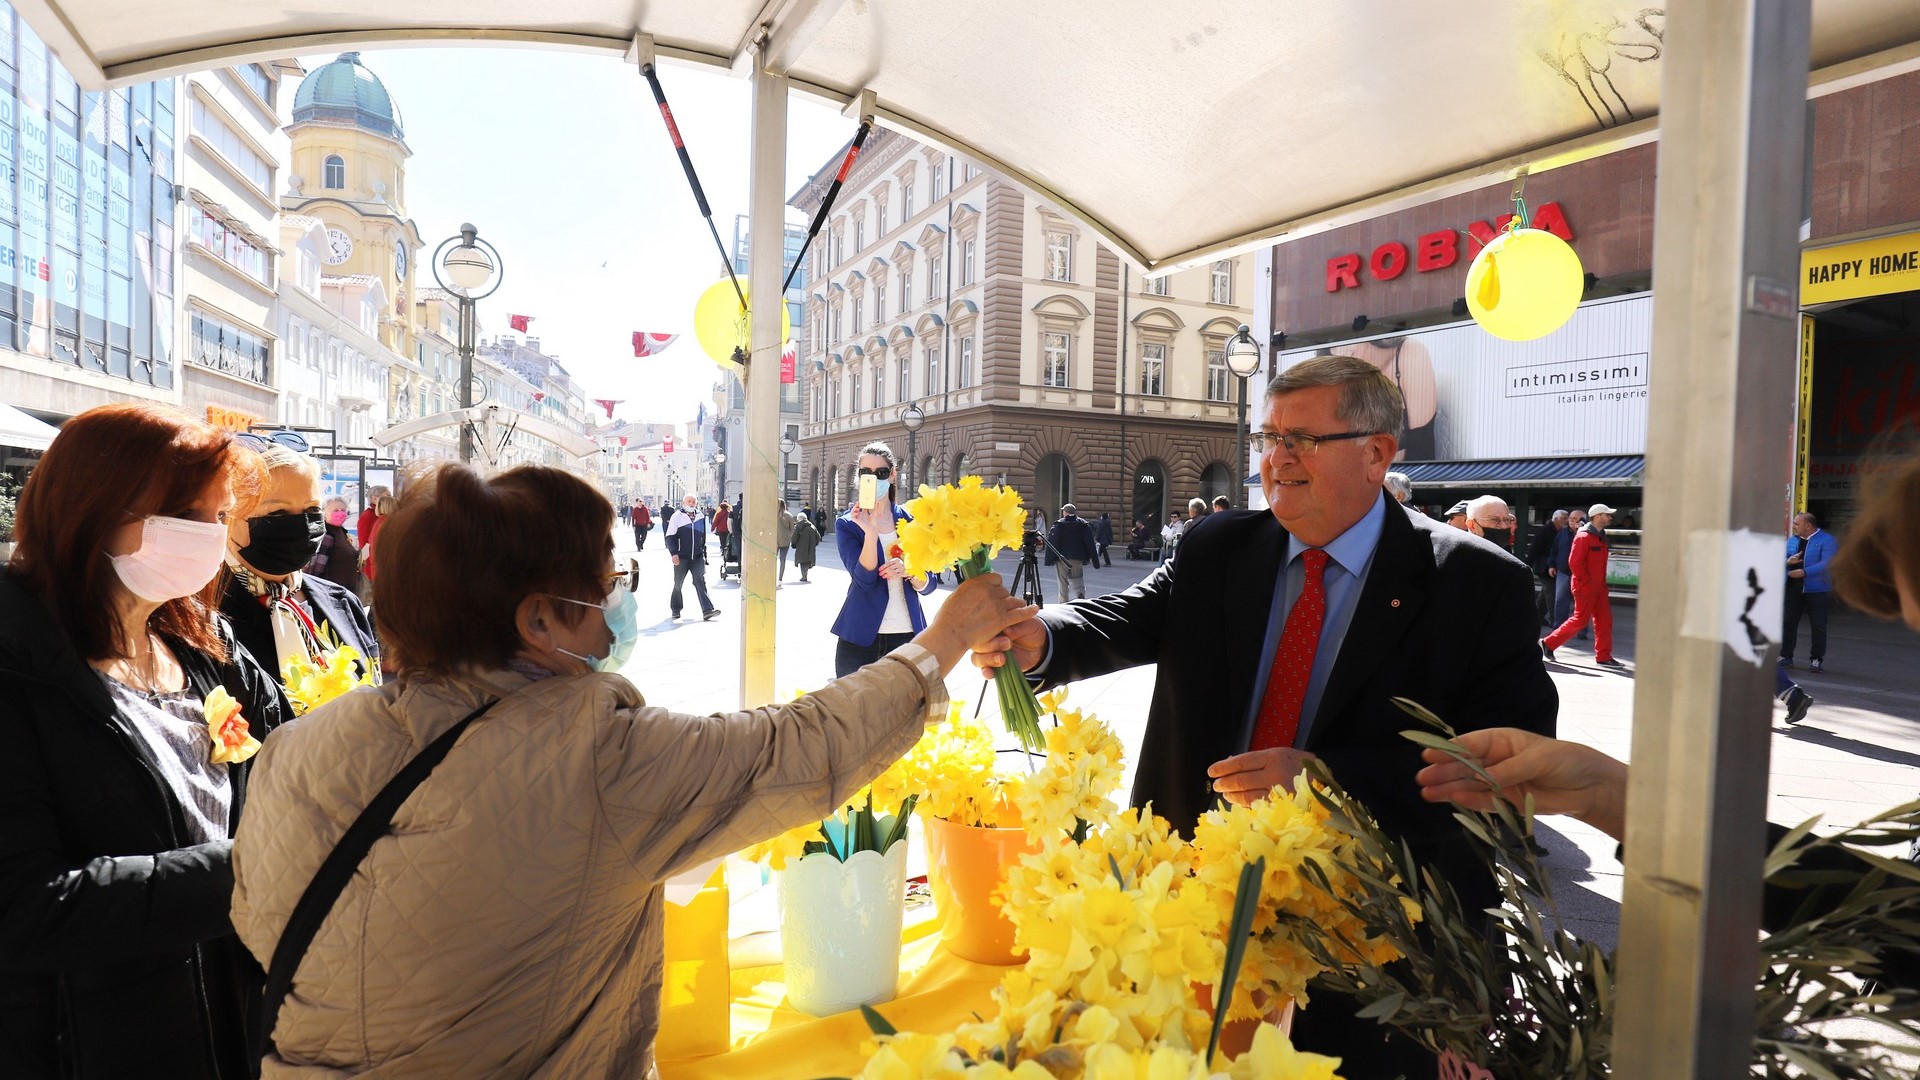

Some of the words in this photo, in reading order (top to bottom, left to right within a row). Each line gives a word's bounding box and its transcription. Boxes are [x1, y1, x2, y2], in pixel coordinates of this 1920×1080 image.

[0, 244, 36, 277] ERTE
[1809, 259, 1863, 285] HAPPY
[1869, 250, 1919, 276] HOME
[1513, 366, 1638, 388] intimissimi
[1558, 394, 1594, 404] Italian
[1599, 388, 1647, 402] lingerie
